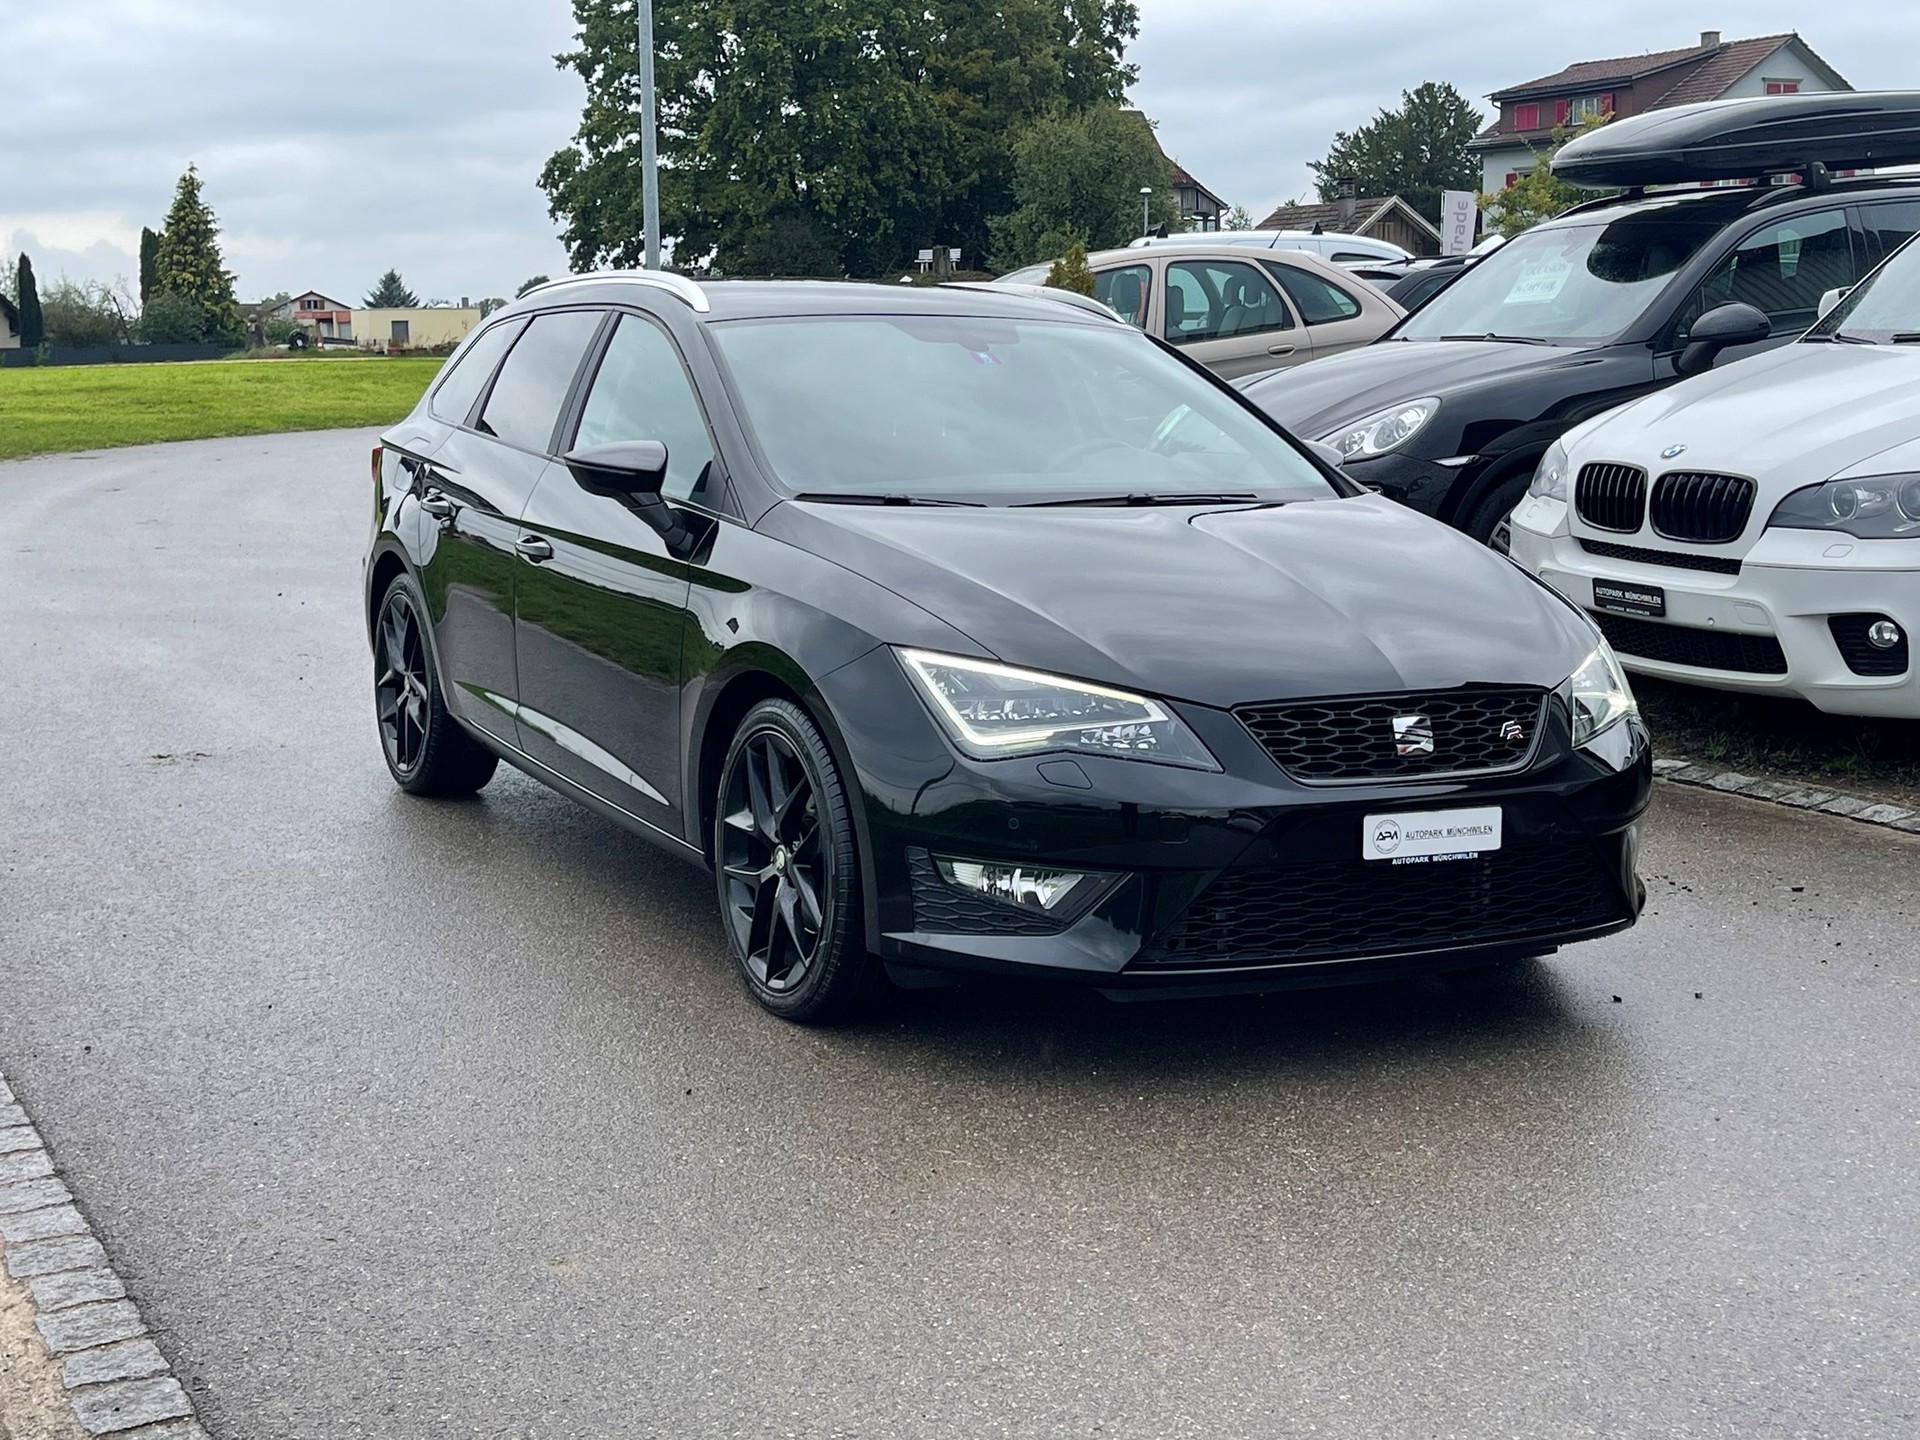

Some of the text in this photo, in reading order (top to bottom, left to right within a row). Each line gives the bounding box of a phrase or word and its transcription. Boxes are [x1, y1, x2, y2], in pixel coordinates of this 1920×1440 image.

[1450, 201, 1469, 254] Trade
[1595, 586, 1623, 598] AUTOPARK
[1405, 825, 1494, 840] AUTOPARK MÜNCHWILEN
[1391, 856, 1430, 866] AUTOPARK
